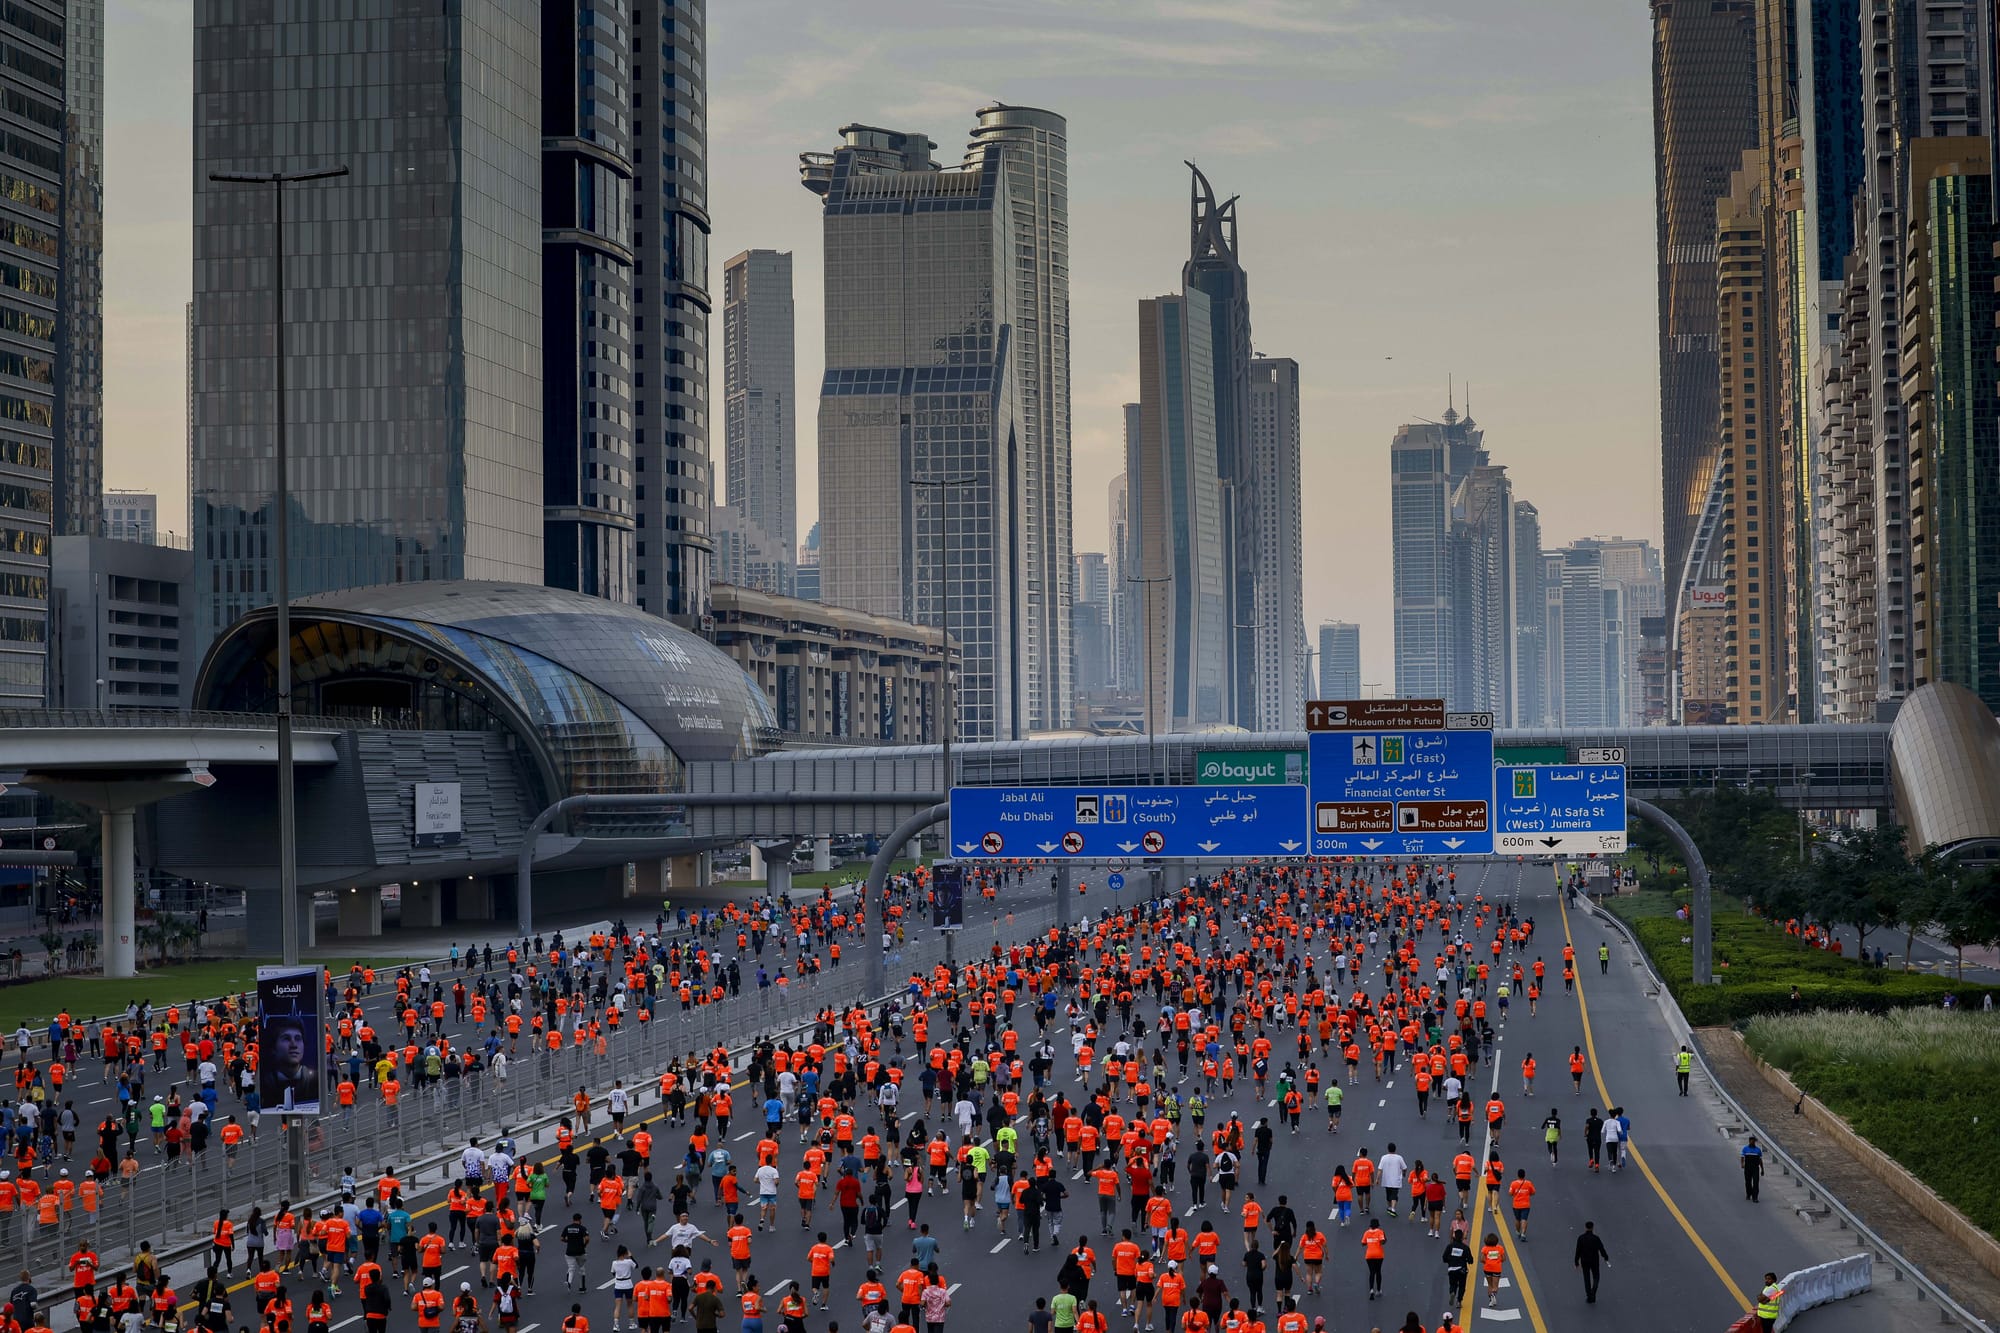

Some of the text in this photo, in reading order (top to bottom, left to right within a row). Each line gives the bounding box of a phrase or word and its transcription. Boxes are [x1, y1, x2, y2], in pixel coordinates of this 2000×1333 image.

[108, 498, 138, 506] EMAAR
[1364, 703, 1442, 714] متحف المستقبل
[1349, 717, 1441, 727] Museum of the Future
[1470, 714, 1489, 727] 50
[1355, 757, 1373, 765] DXB
[1385, 749, 1400, 761] 71
[1409, 753, 1446, 765] (East)
[1602, 749, 1621, 761] 50
[1221, 761, 1276, 782] bayut
[1550, 769, 1620, 784] شارع الصفا
[1344, 769, 1459, 787] شارع المركز المالي
[1344, 787, 1446, 797] Financial Center St
[1517, 783, 1533, 795] 71
[1586, 788, 1620, 802] جميرا
[1000, 792, 1044, 802] Jabal Ali
[1204, 790, 1257, 807] جبل علي
[1000, 811, 1054, 822] Abu Dhabi
[1109, 809, 1121, 821] 11
[1209, 809, 1237, 827] ظبي
[1340, 806, 1391, 818] برج خليفة
[1442, 805, 1485, 819] دبي مول
[1550, 807, 1605, 817] Al Safa St
[1132, 812, 1176, 825] (South)
[1420, 819, 1485, 828] The Dubai Mall
[1550, 819, 1592, 829] Jumeira
[1340, 820, 1390, 830] Burj Khalifa
[1505, 819, 1545, 832] (West)
[1316, 839, 1348, 849] 300m
[1502, 837, 1534, 847] 600m
[1405, 845, 1424, 853] EXIT
[272, 984, 302, 995] الفضول
